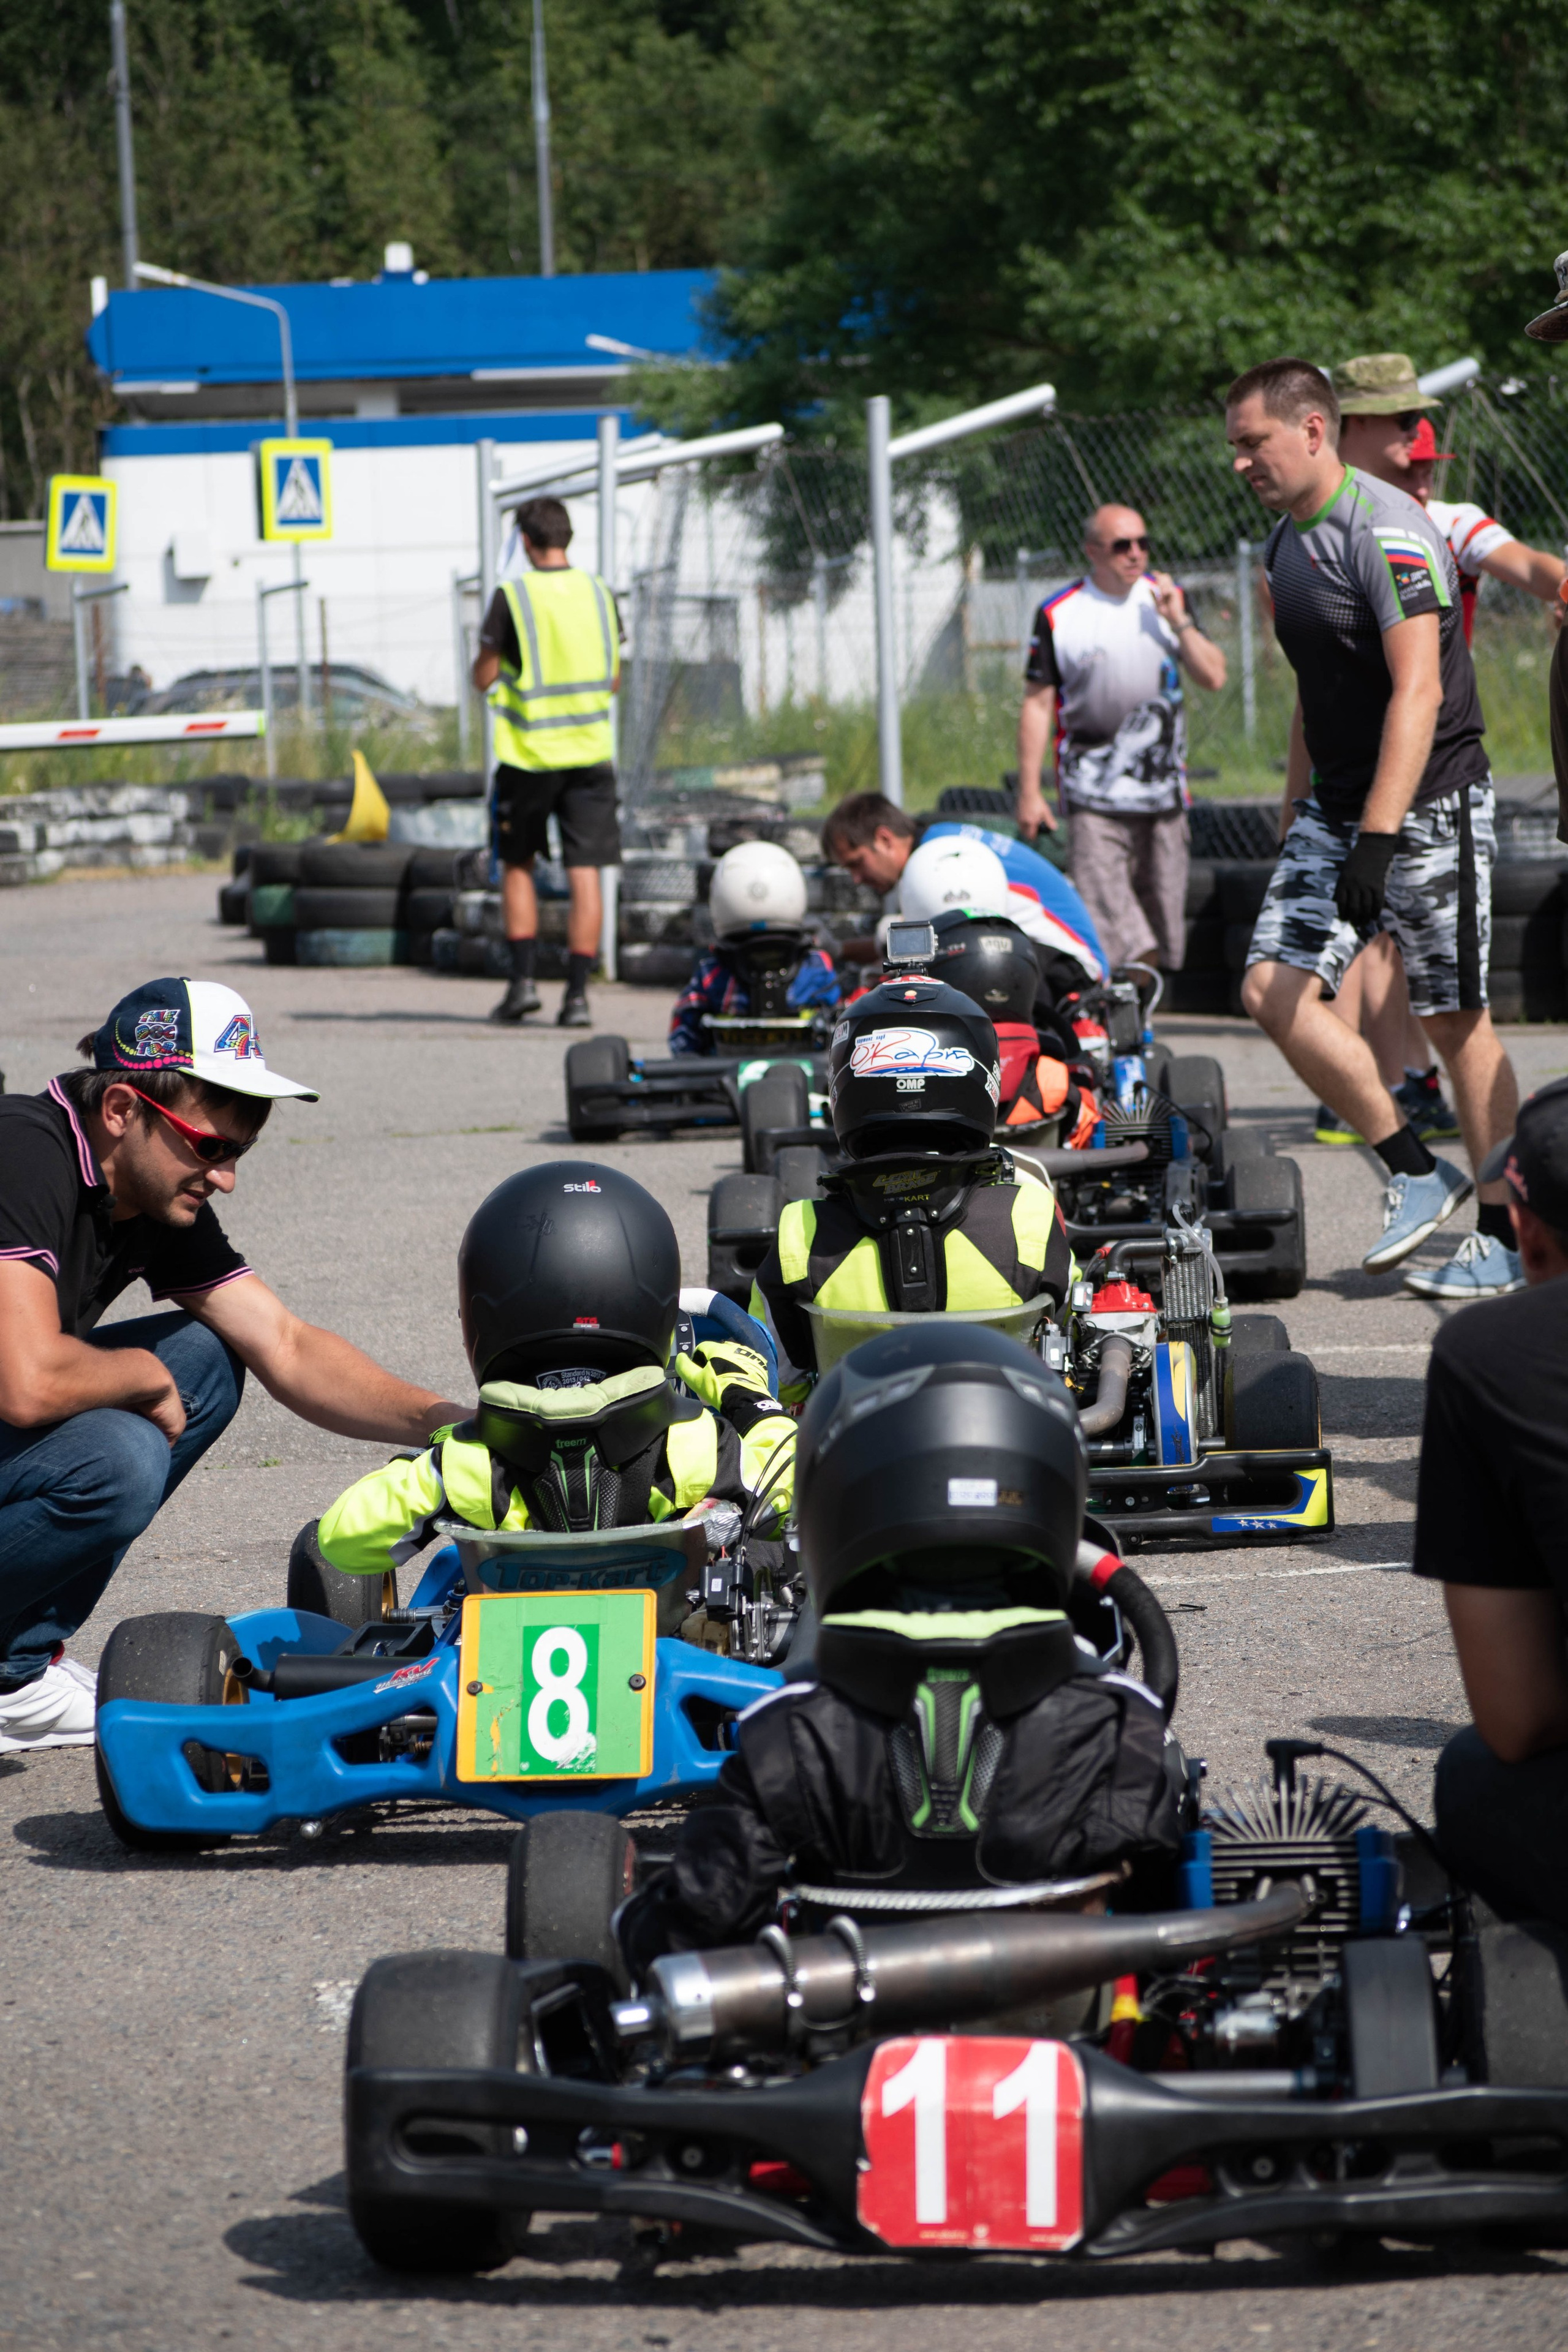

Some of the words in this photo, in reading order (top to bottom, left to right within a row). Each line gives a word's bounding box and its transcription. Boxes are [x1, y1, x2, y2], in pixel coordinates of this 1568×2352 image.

[135, 1025, 178, 1041] DOC
[136, 1041, 176, 1057] TOR
[897, 1078, 925, 1090] OMP
[883, 1171, 938, 1194] BRACE
[560, 1370, 586, 1378] Standard
[528, 1626, 589, 1762] 8
[882, 2038, 1057, 2228] 11
